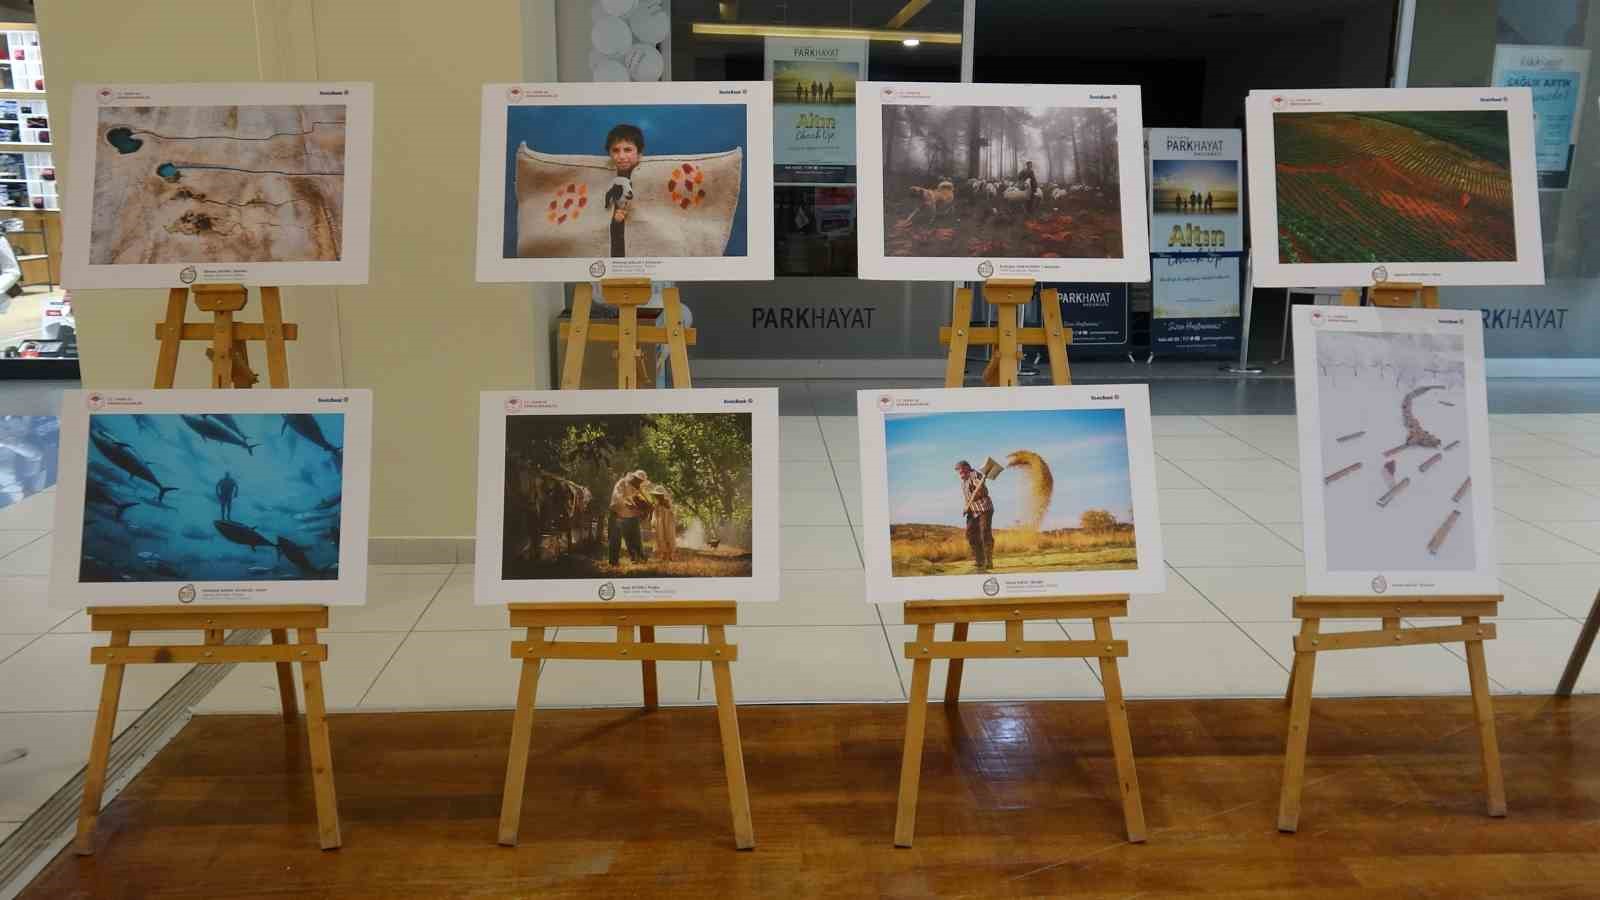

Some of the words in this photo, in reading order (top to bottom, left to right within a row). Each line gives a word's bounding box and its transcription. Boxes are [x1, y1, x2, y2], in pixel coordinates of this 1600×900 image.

[1167, 140, 1223, 152] PARKHAYAT
[1057, 292, 1111, 304] PARKHAYAT
[752, 307, 877, 329] PARKHAYAT
